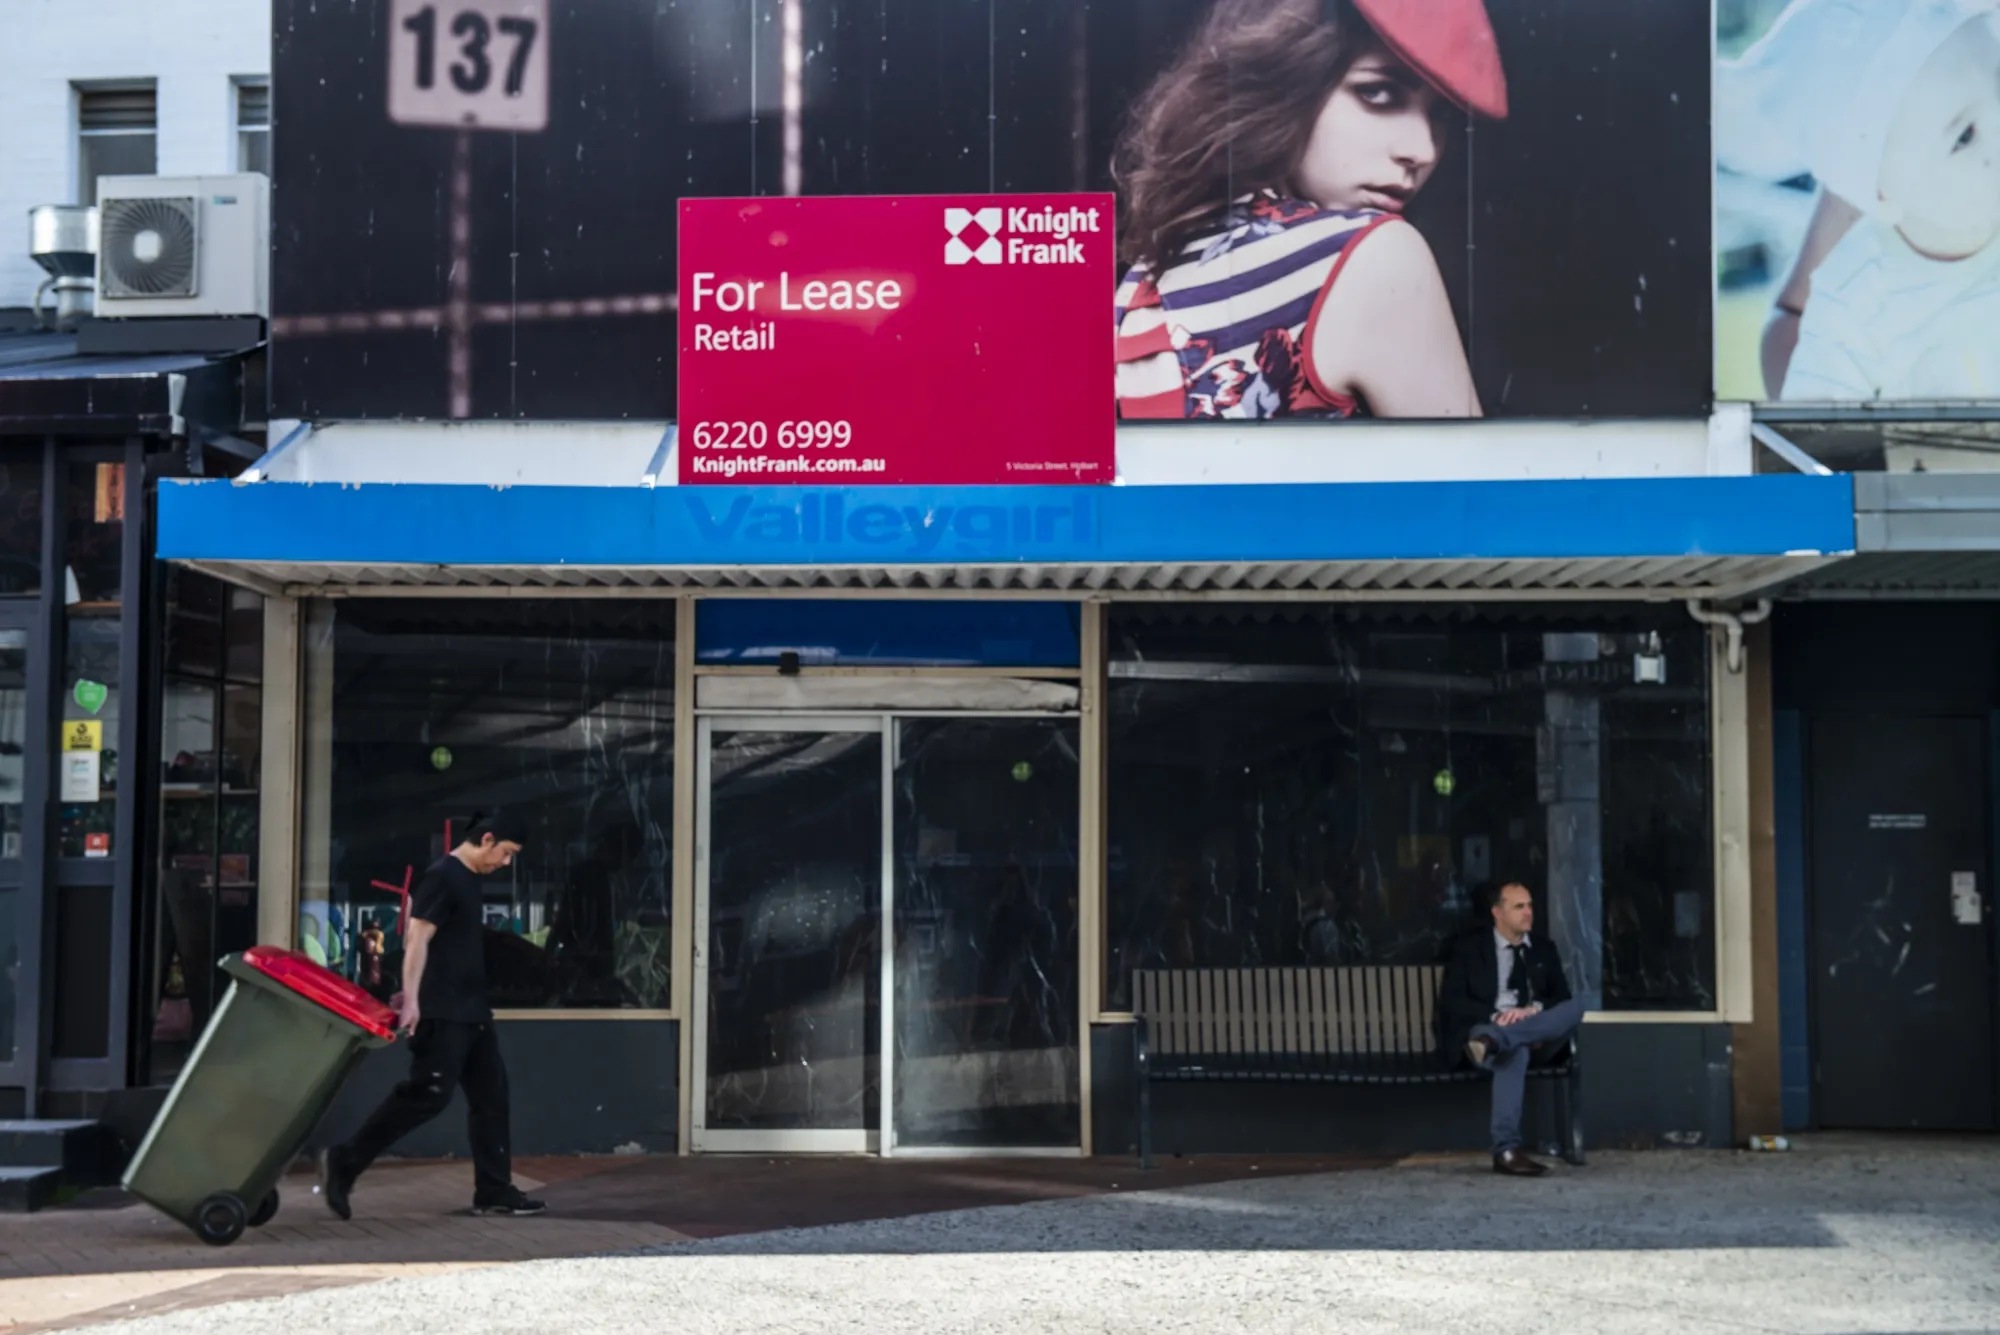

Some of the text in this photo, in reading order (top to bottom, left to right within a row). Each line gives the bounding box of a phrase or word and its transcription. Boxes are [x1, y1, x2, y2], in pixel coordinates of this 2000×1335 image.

[403, 4, 538, 97] 137
[1008, 206, 1100, 238] Knight
[1008, 239, 1085, 264] Frank
[692, 272, 901, 311] For Lease
[694, 322, 775, 351] Retail
[693, 421, 851, 449] 6220 6999
[693, 455, 885, 476] KnightFrank.com.au
[687, 493, 1092, 555] Valleygirl
